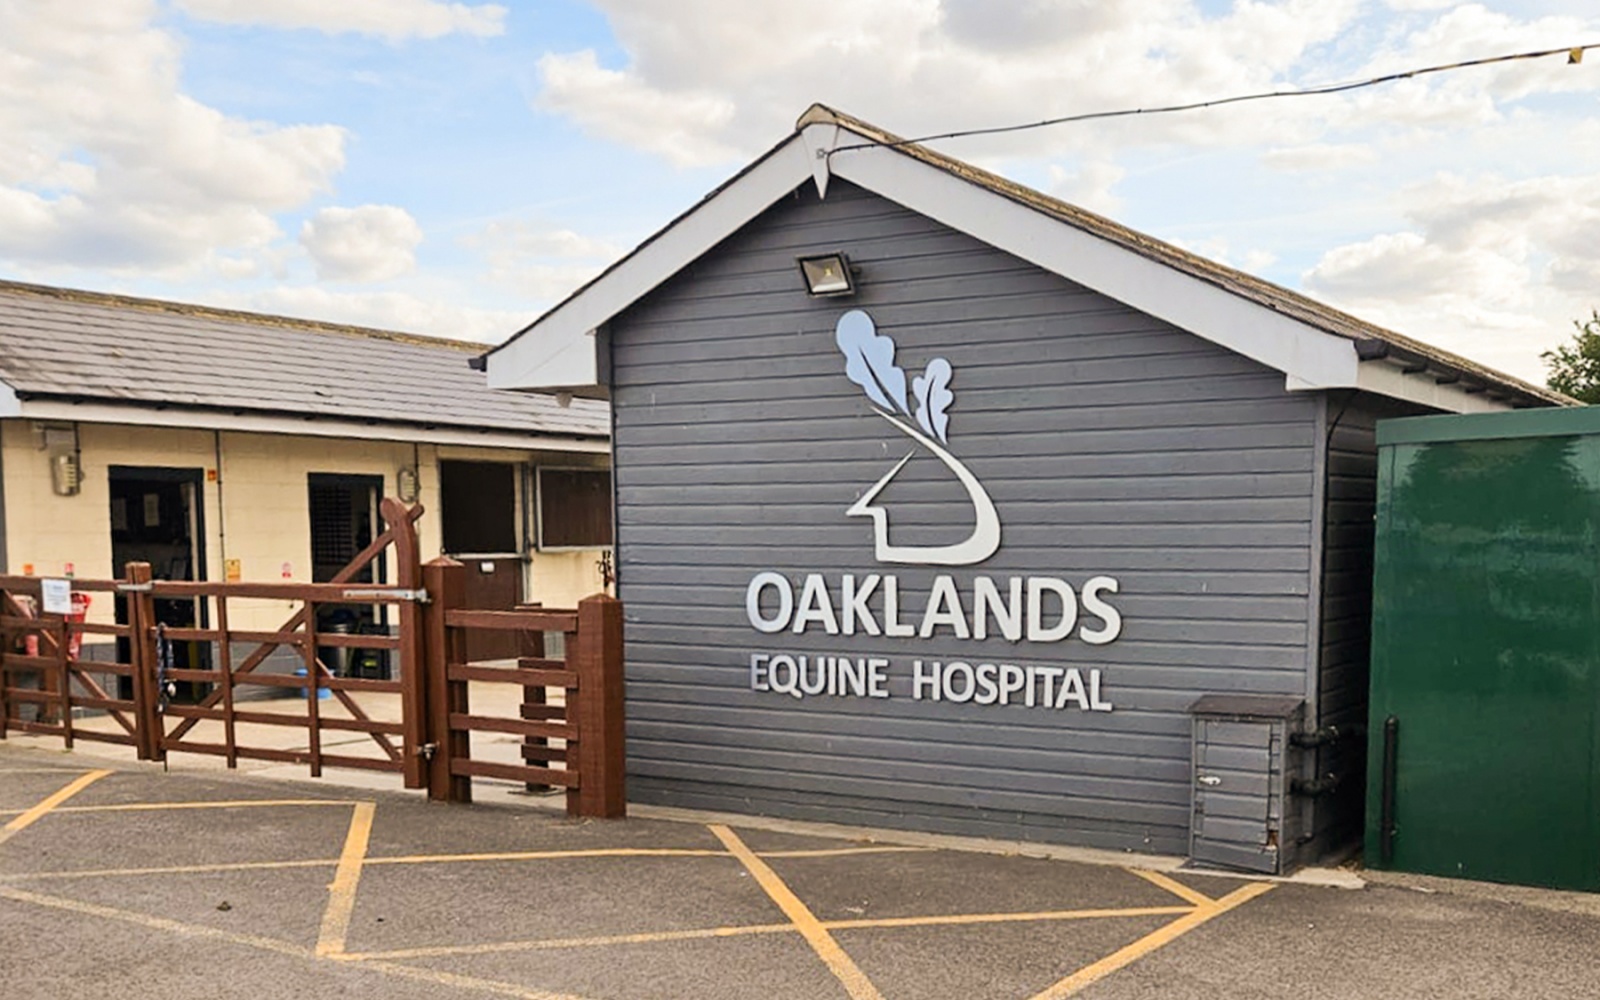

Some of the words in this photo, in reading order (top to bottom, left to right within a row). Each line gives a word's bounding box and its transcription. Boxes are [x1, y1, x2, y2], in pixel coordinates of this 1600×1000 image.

[746, 571, 1122, 644] OAKLANDS
[750, 653, 889, 698] EQUINE
[912, 659, 1113, 711] HOSPITAL
